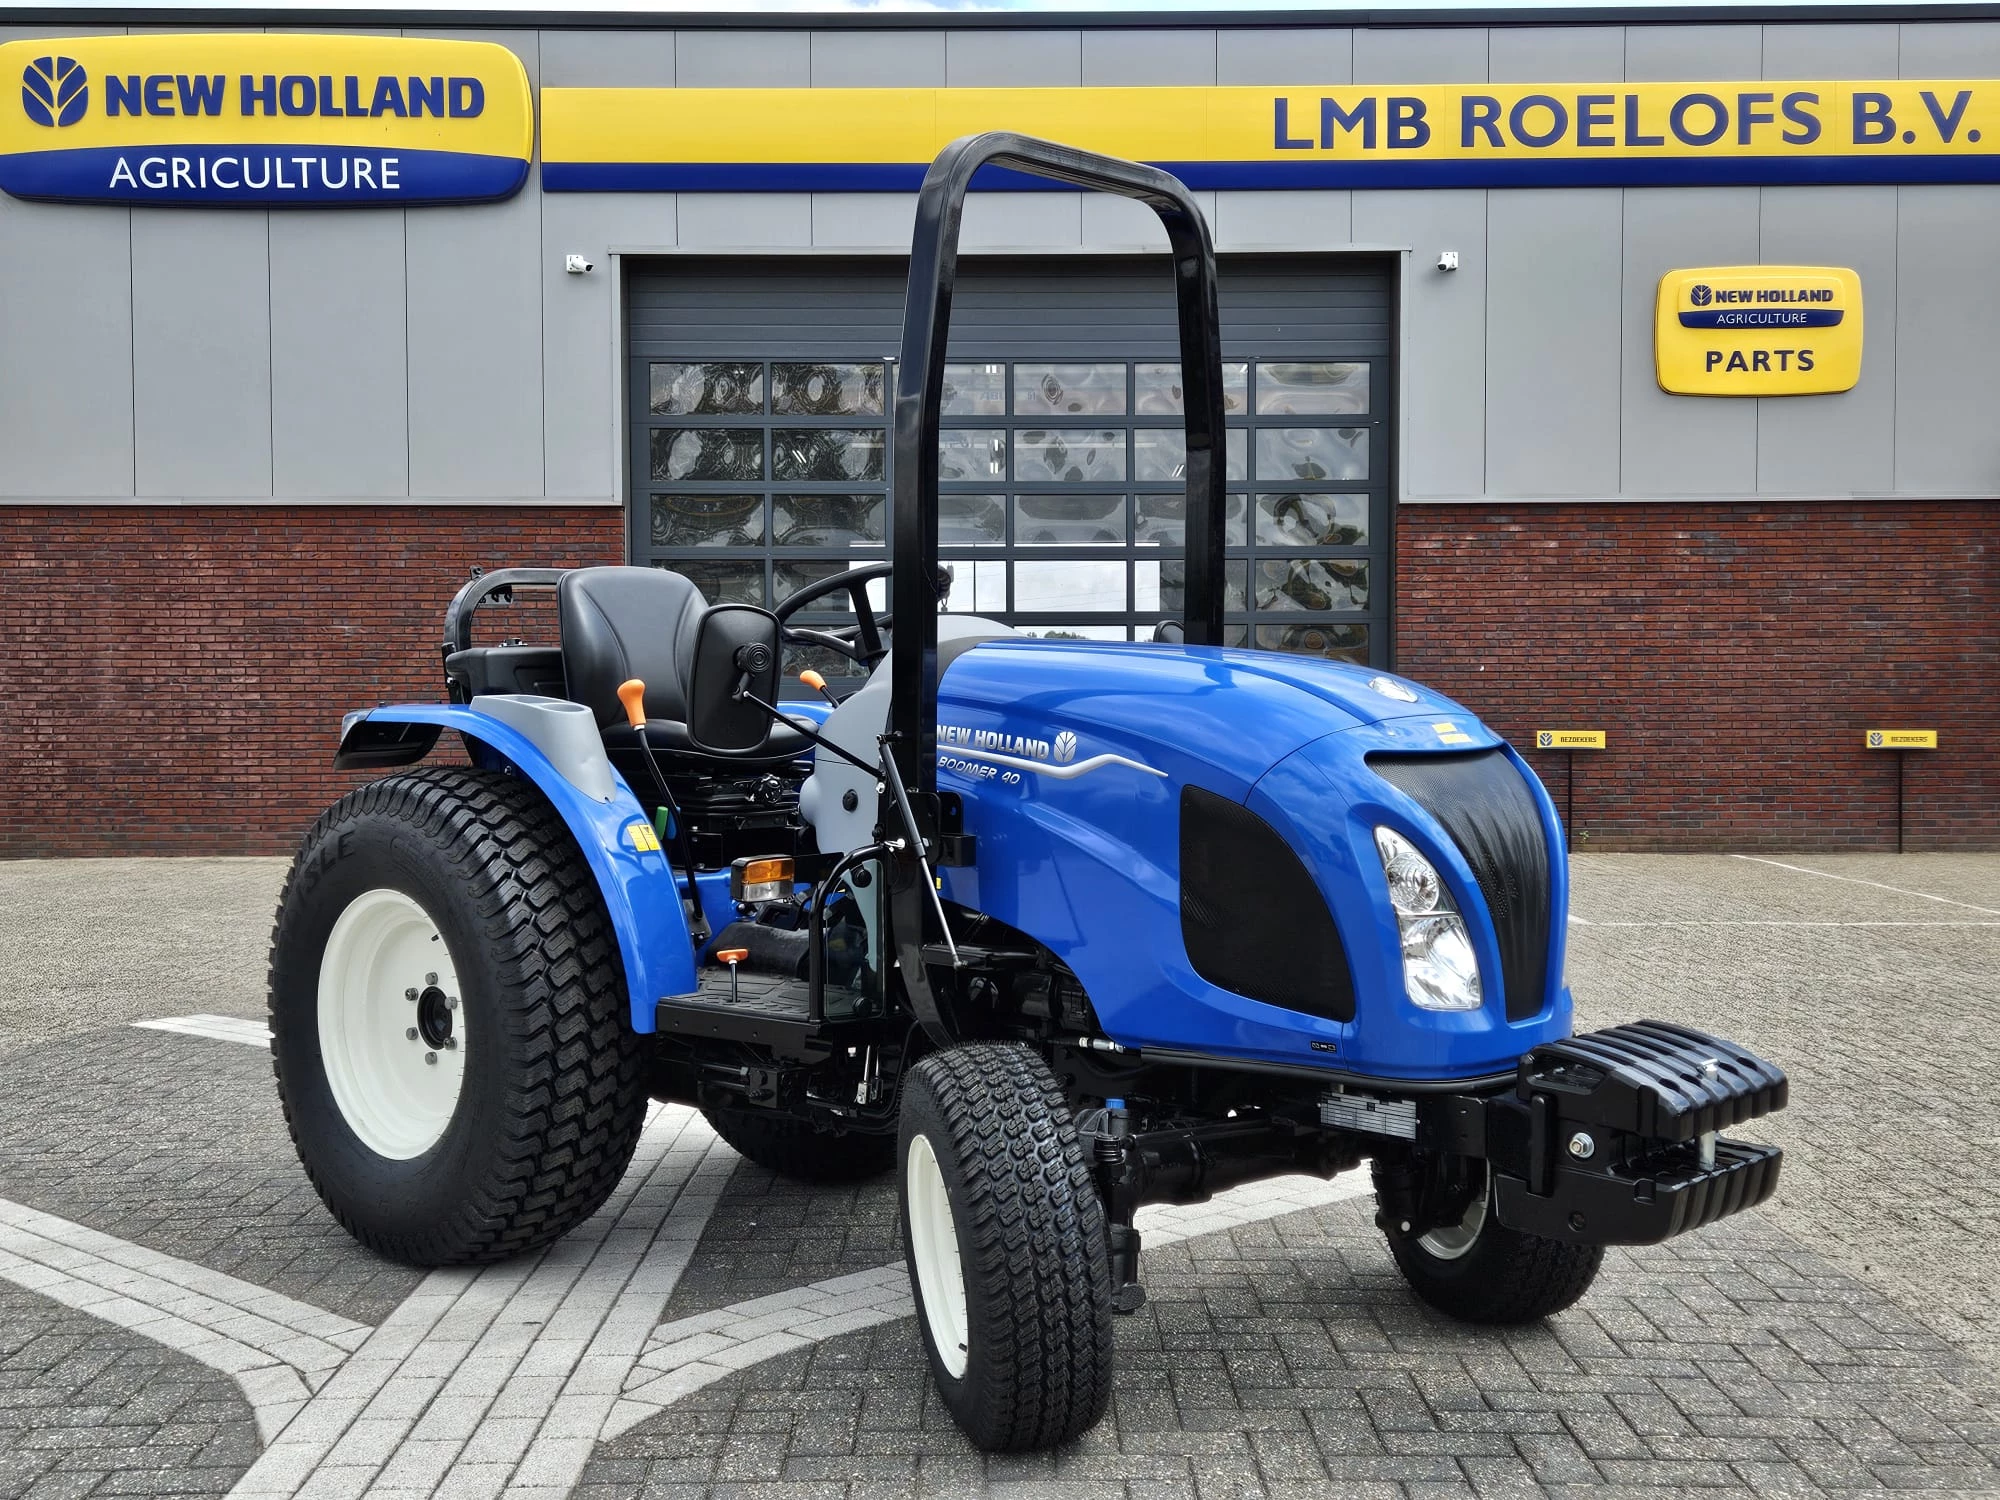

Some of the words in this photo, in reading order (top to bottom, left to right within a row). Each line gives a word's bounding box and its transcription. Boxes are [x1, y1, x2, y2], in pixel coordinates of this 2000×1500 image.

[105, 74, 225, 117] NEW
[240, 74, 485, 118] HOLLAND
[1274, 96, 1431, 150] LMB
[1460, 90, 1823, 148] ROELOFS
[1851, 90, 1982, 146] B.V.
[109, 156, 401, 190] AGRICULTURE
[1716, 290, 1754, 303] NEW
[1757, 289, 1834, 303] HOLLAND
[1716, 313, 1808, 325] AGRICULTURE
[1706, 349, 1815, 373] PARTS
[937, 724, 971, 745] NEW
[974, 729, 1050, 760] HOLLAND
[938, 756, 998, 780] BOOMER
[1001, 771, 1021, 785] 40
